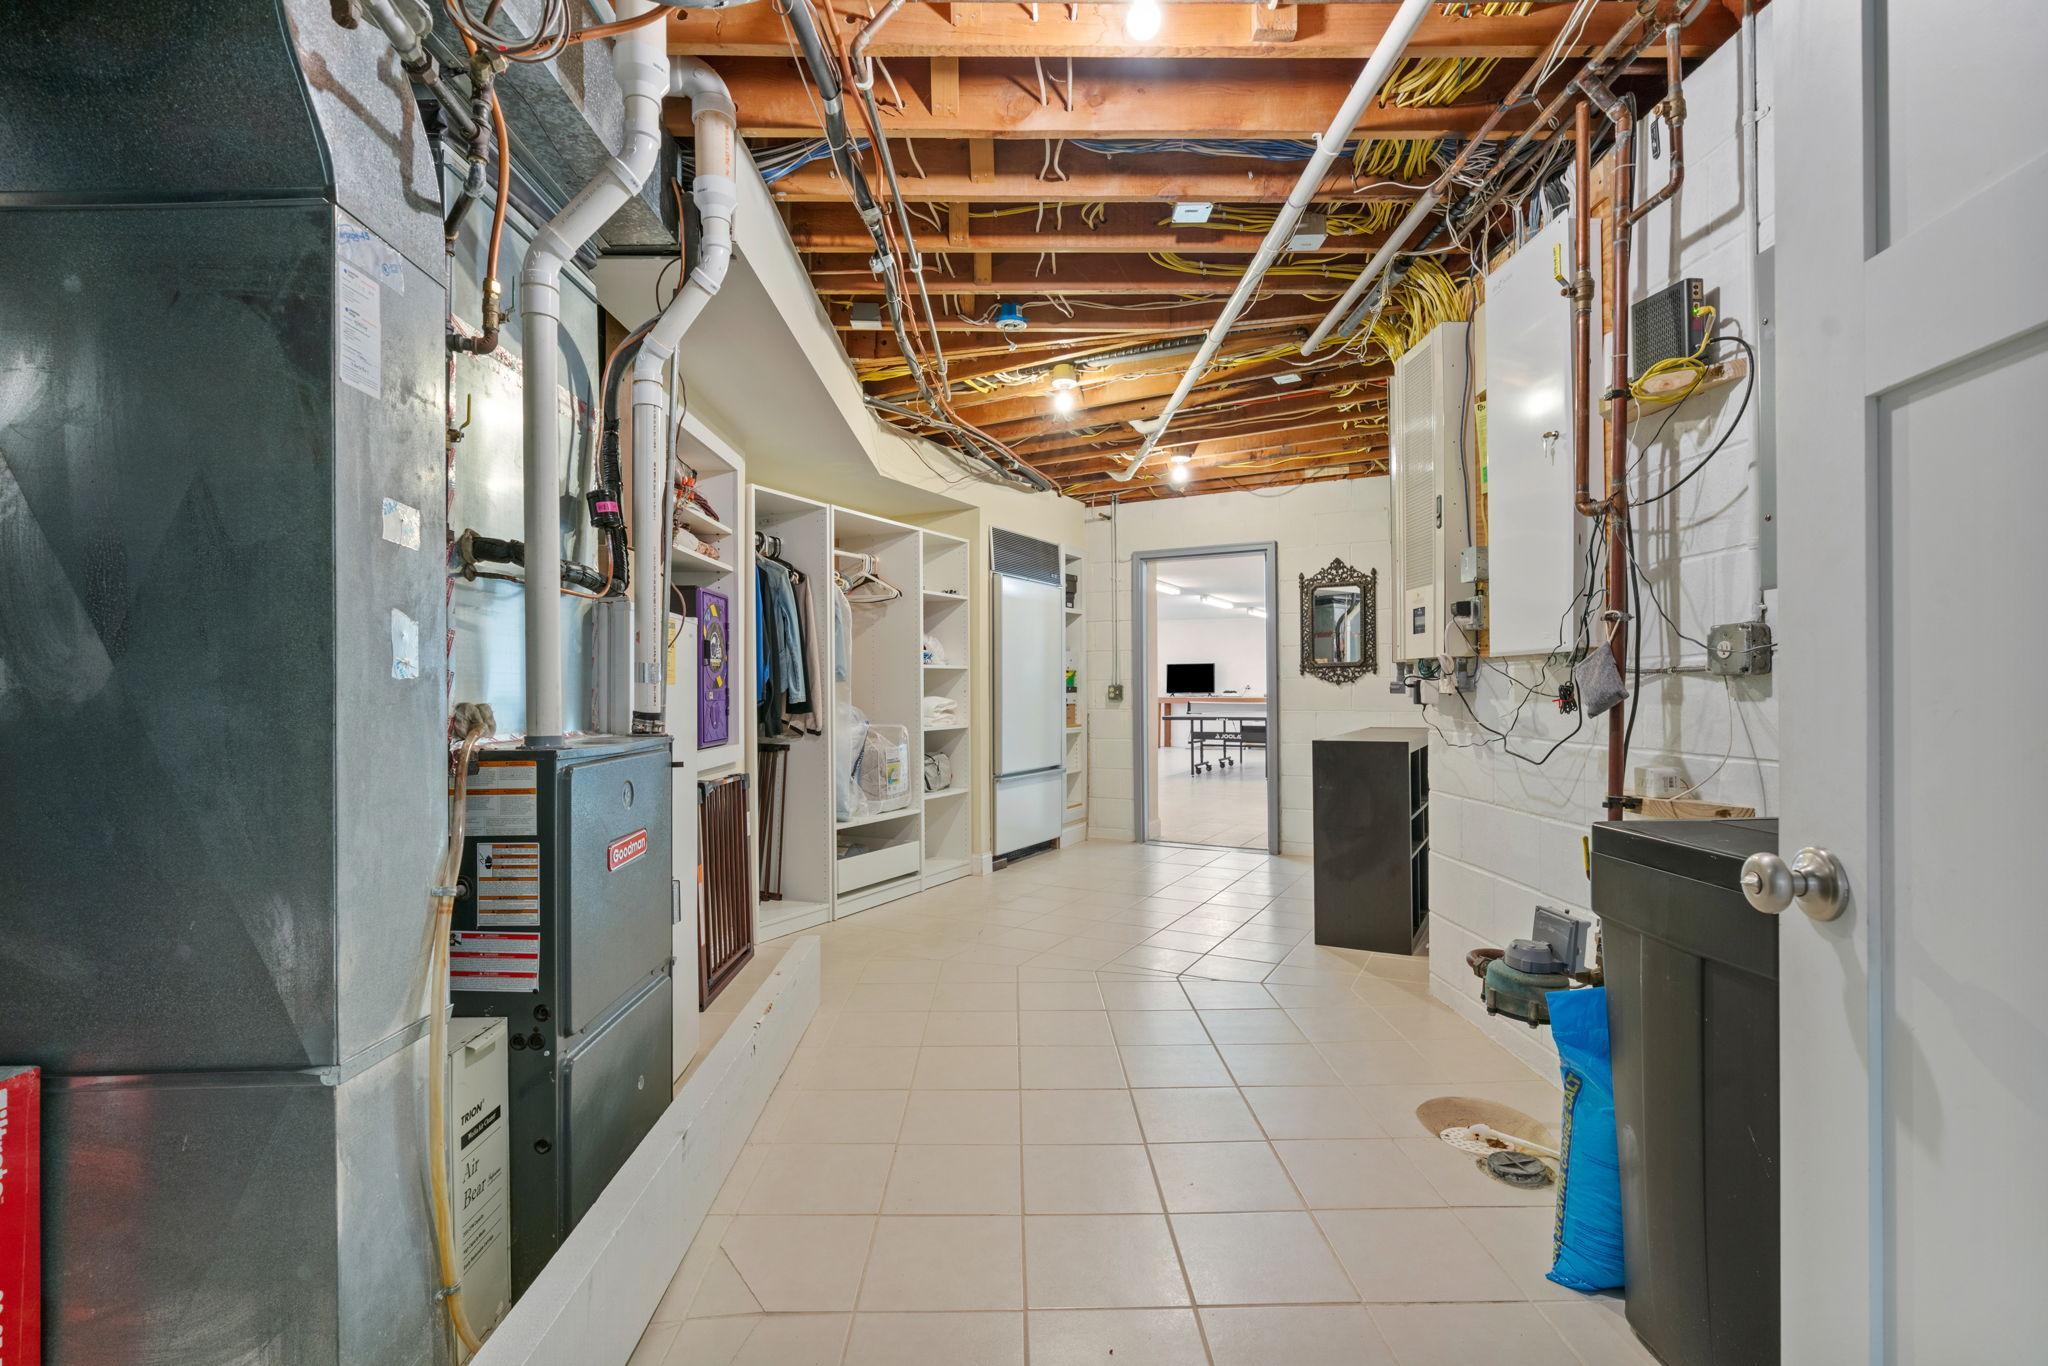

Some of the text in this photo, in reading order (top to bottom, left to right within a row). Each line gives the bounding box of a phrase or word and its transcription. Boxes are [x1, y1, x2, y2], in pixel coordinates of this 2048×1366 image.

[613, 837, 646, 862] Goodman
[1564, 1072, 1580, 1110] SALT
[461, 1101, 483, 1126] TRION
[463, 1158, 480, 1184] Air
[463, 1178, 486, 1210] Bear
